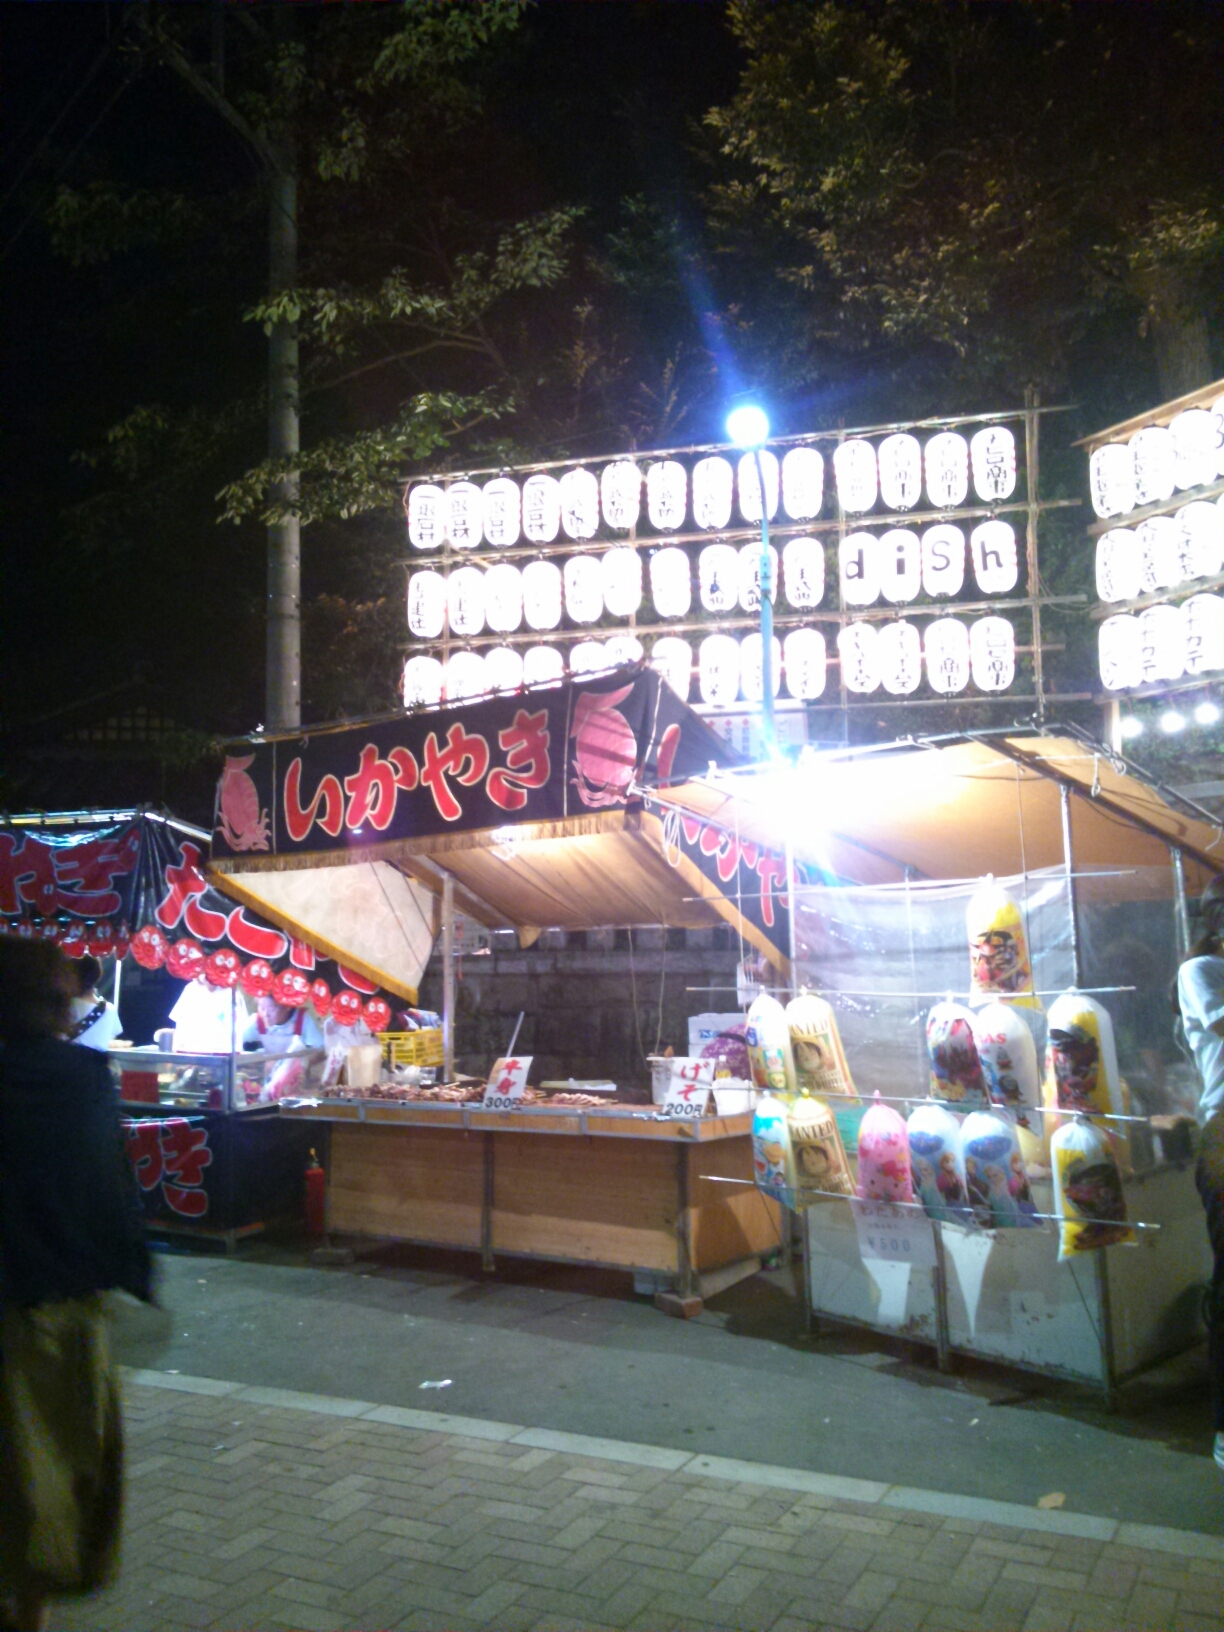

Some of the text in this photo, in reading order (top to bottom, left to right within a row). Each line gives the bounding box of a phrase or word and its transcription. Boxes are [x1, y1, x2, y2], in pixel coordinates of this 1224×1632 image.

[282, 708, 552, 842] いかやき
[677, 1061, 711, 1101] げそ
